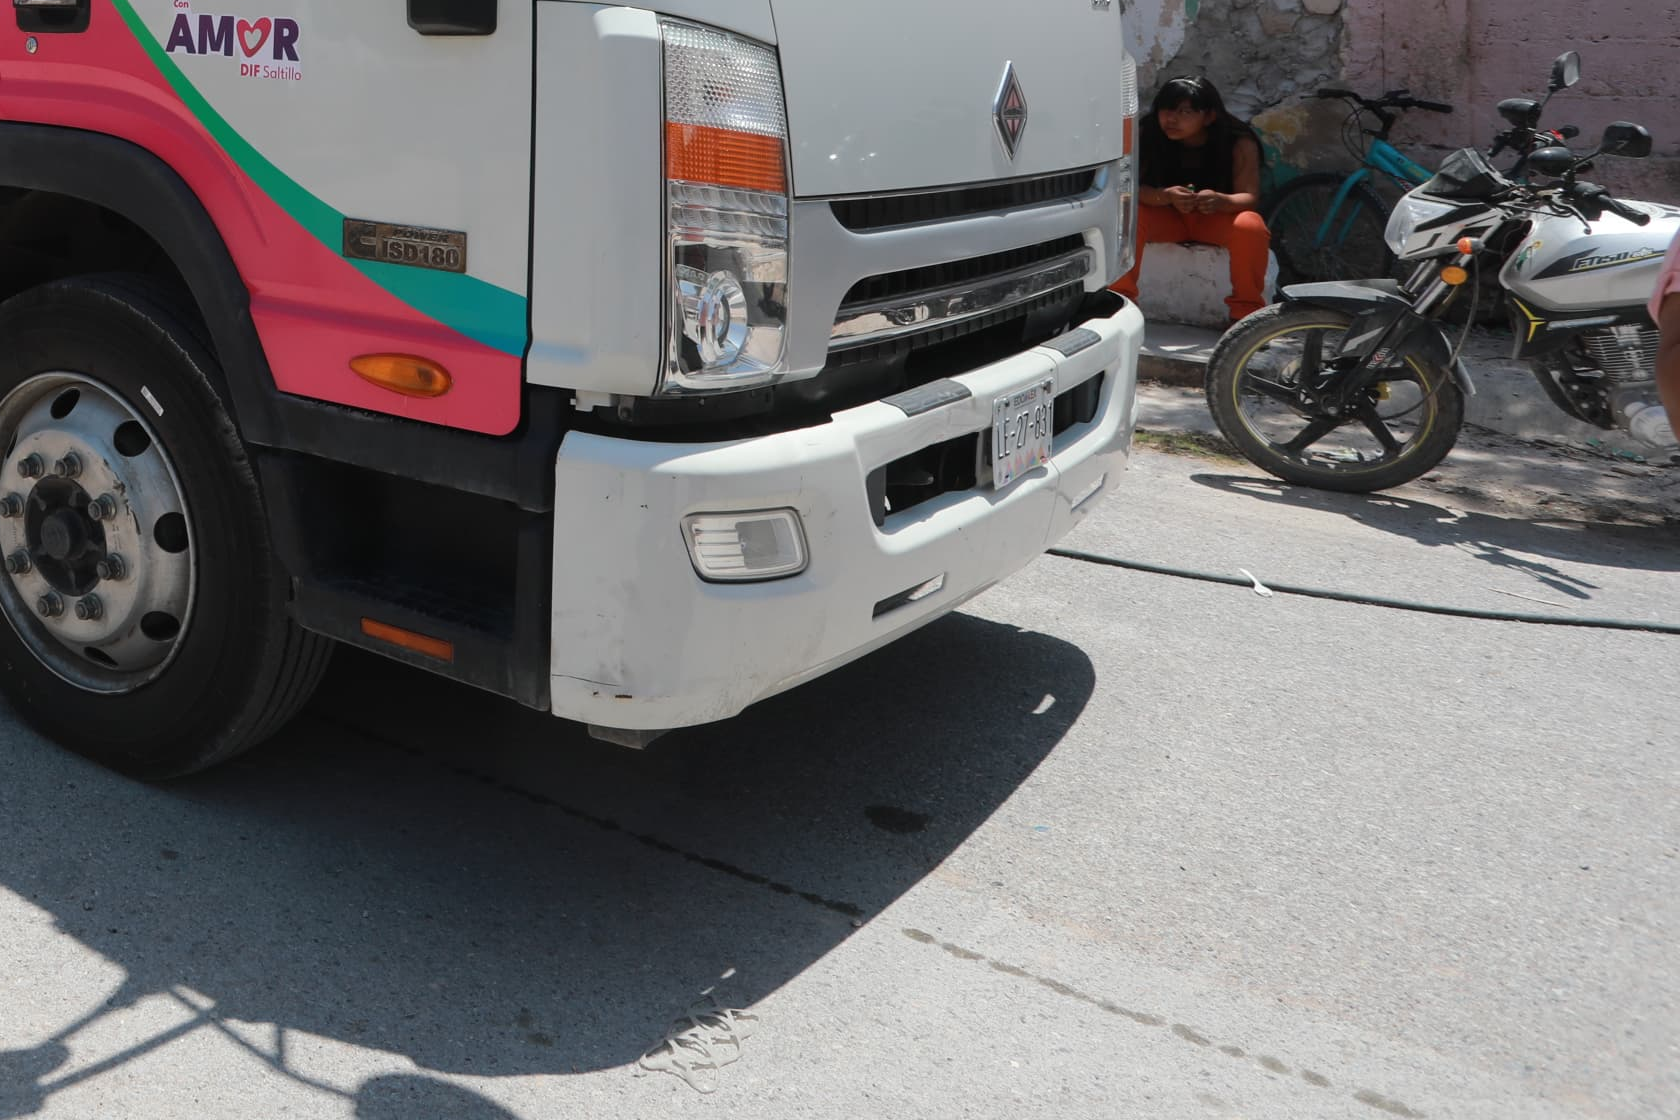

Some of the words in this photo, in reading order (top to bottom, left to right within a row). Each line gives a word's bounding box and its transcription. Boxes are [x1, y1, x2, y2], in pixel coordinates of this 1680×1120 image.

[174, 0, 189, 8] Con
[166, 13, 299, 61] AMOR
[240, 64, 260, 77] DIF
[263, 66, 302, 81] Saltillo
[391, 227, 449, 243] POWER
[381, 239, 460, 268] ISD180
[996, 400, 1052, 460] LE-27-831
